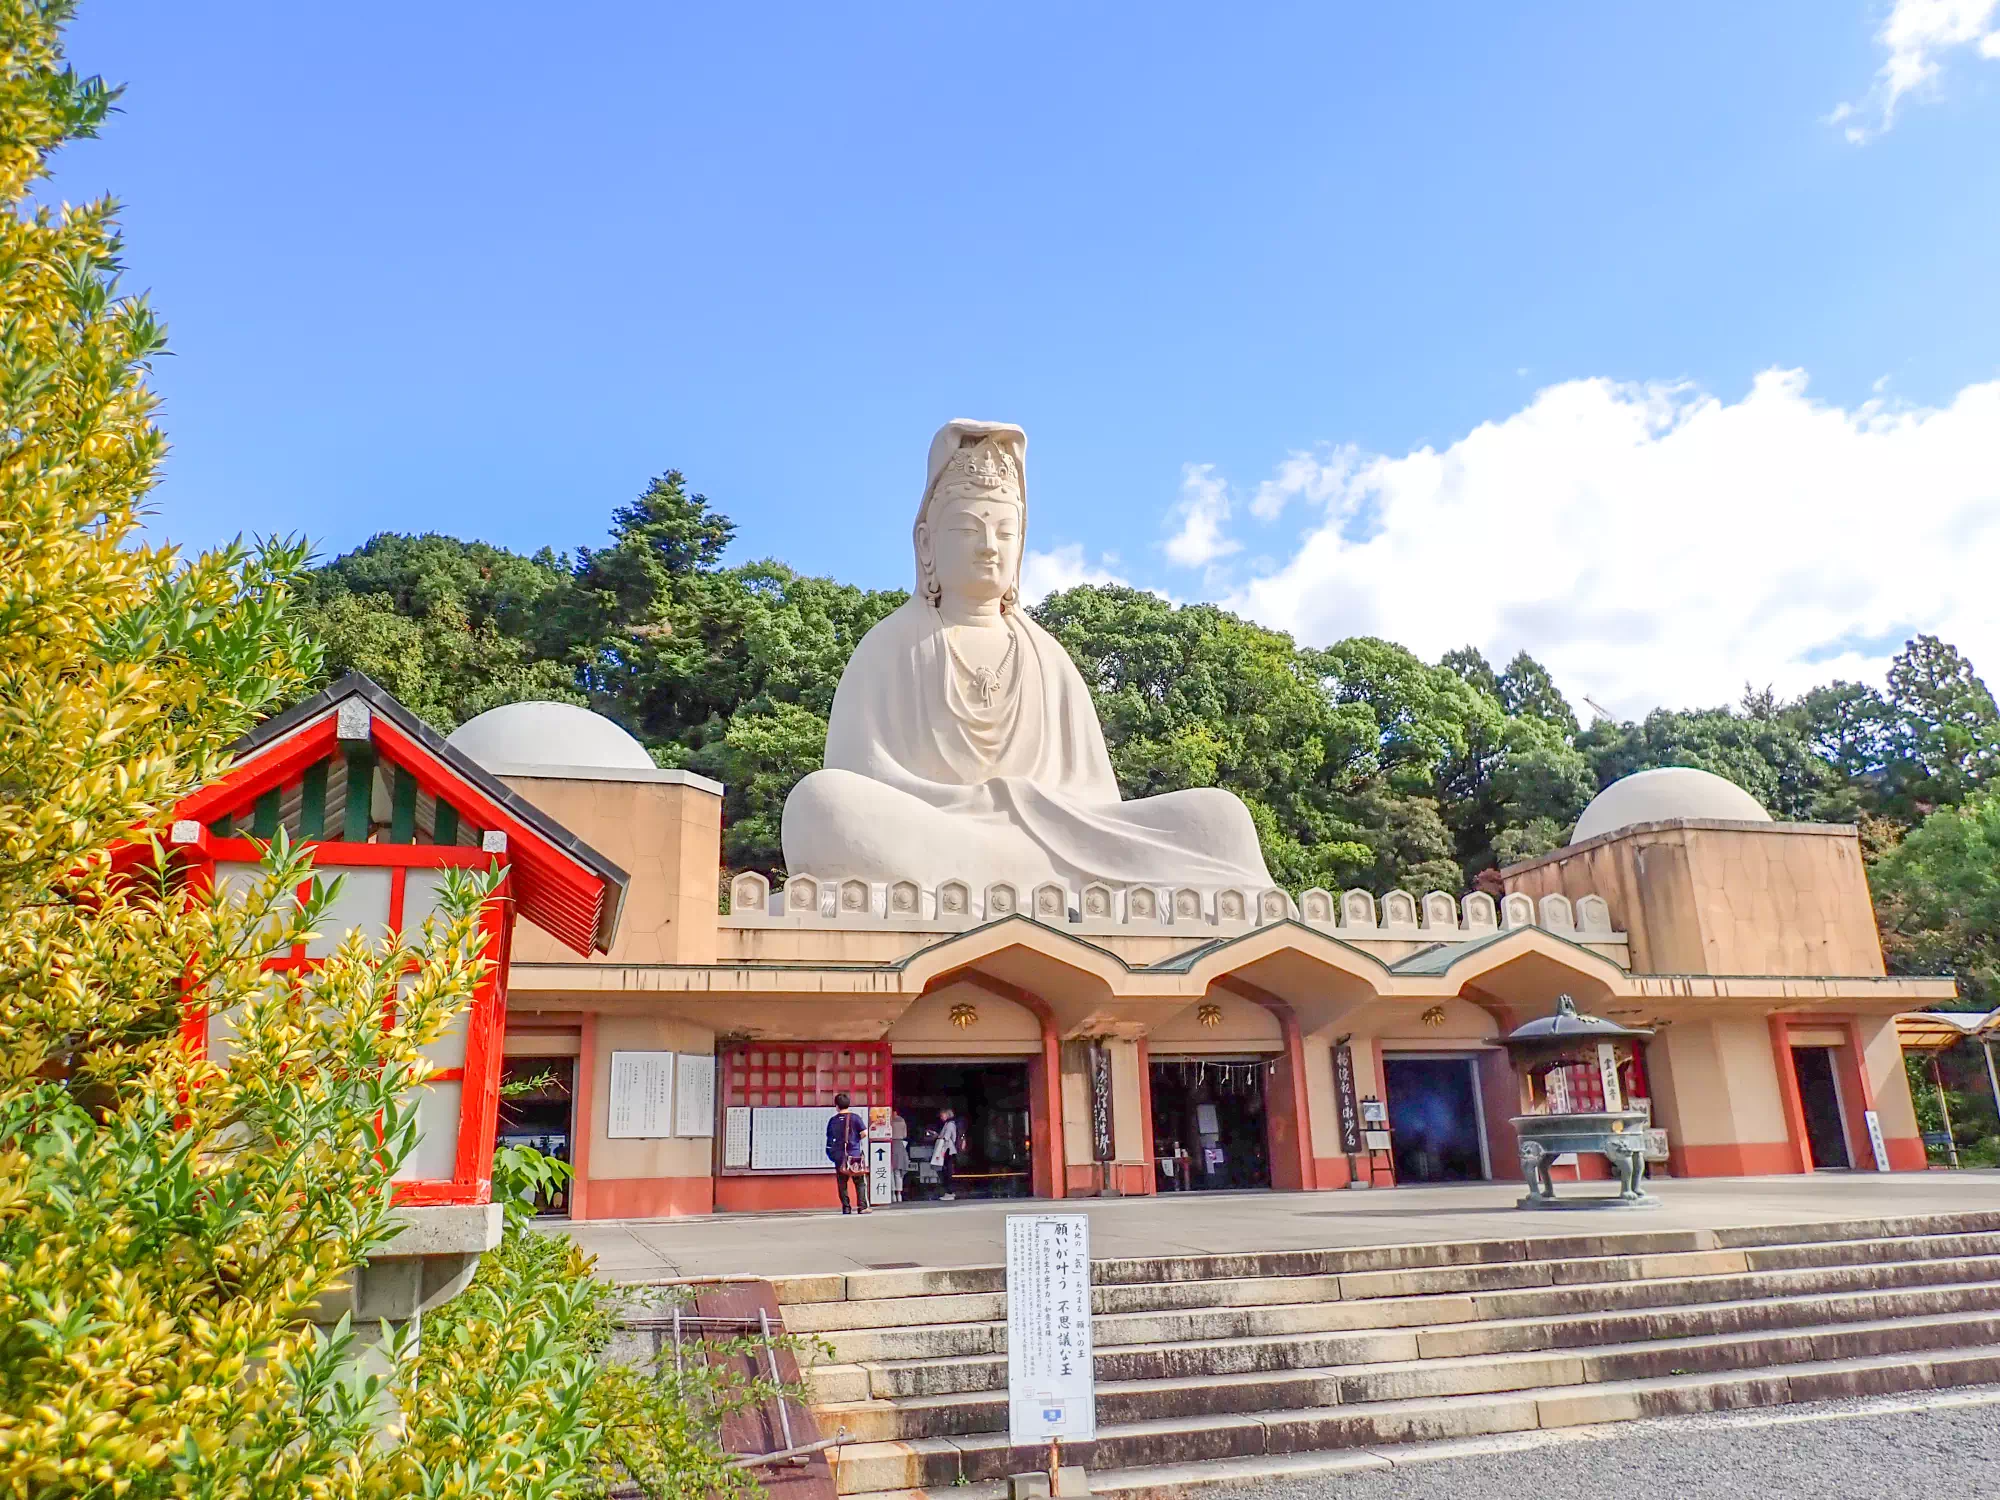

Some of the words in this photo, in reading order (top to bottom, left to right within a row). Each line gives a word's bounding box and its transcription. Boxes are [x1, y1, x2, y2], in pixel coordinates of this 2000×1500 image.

[875, 1167, 887, 1195] 受付
[1054, 1222, 1069, 1290] 願いが叶う
[1057, 1300, 1073, 1376] 不思議な玉
